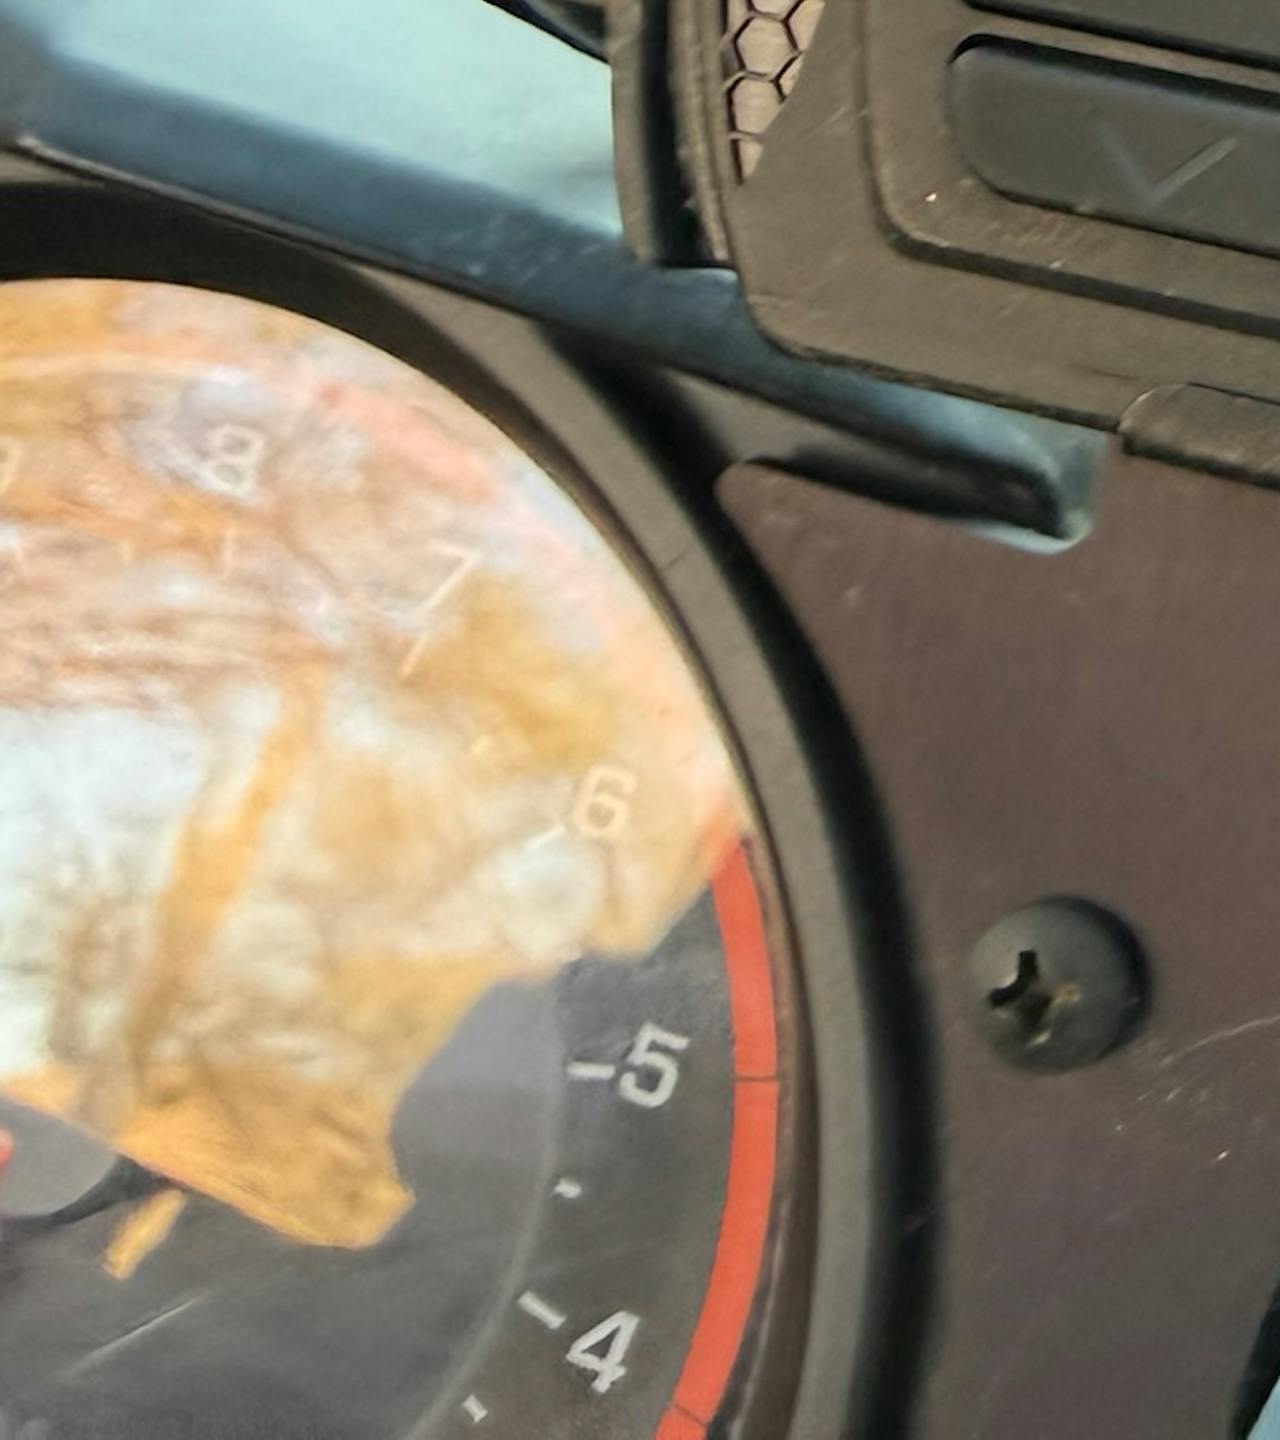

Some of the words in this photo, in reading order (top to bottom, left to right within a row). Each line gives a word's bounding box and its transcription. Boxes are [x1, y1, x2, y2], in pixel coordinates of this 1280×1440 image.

[203, 423, 265, 498] 8
[572, 763, 637, 840] 6
[618, 1019, 690, 1109] 5
[565, 1310, 641, 1393] 4
